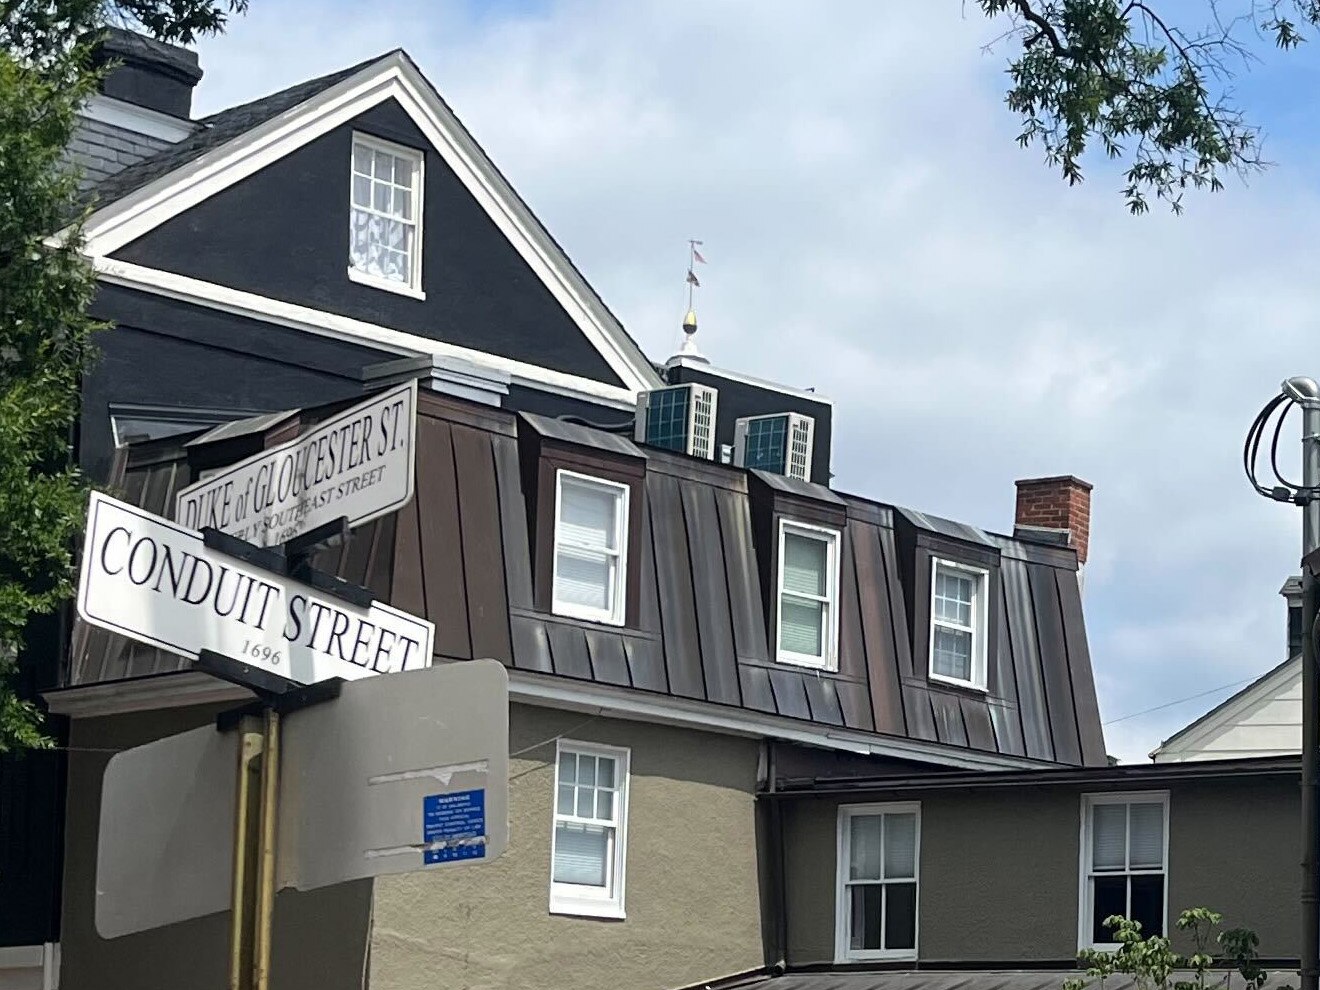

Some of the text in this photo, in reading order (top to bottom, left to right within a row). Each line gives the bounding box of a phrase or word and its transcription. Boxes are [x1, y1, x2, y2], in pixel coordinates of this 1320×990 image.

[186, 400, 404, 531] DUKE of GLOUCESTER ST.
[336, 465, 387, 500] STREET
[101, 526, 419, 674] CONDUIT STREET
[241, 639, 281, 666] 1696
